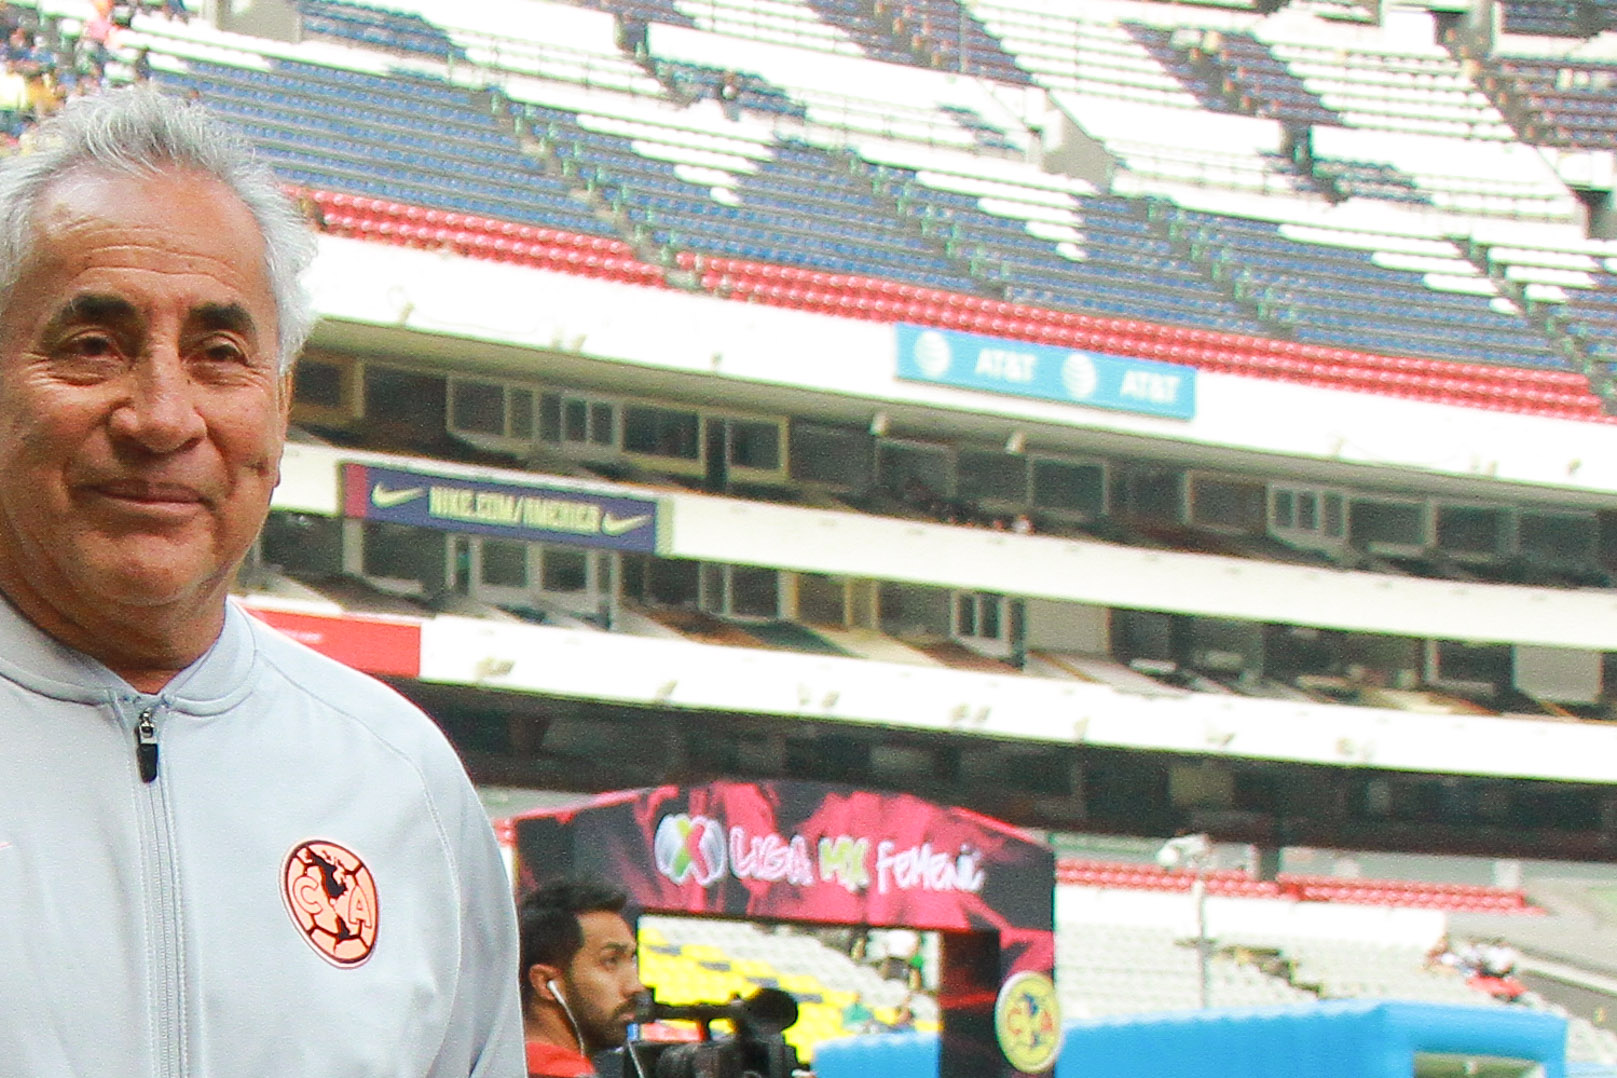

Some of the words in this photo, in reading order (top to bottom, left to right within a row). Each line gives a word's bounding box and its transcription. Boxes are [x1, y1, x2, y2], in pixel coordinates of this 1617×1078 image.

[974, 347, 1037, 382] AT&T
[1119, 369, 1182, 404] AT&T
[817, 835, 870, 893] MX
